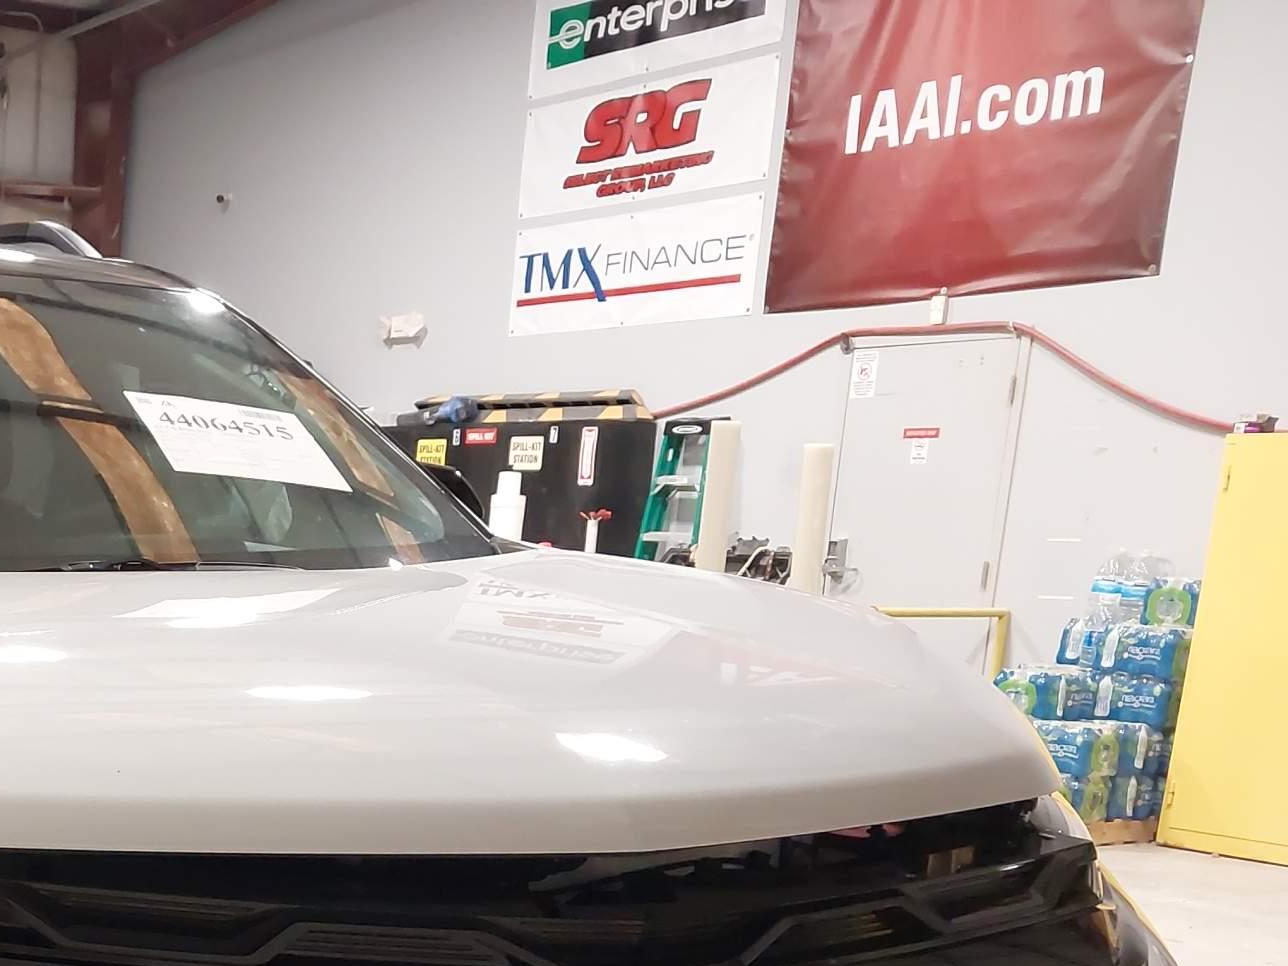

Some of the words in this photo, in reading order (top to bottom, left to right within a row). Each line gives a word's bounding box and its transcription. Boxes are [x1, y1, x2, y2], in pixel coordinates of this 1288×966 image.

[576, 78, 712, 164] SRG
[844, 66, 1104, 155] IAAI.com
[519, 243, 607, 302] TMX
[605, 234, 747, 276] FINANCE
[159, 411, 294, 441] 44064515
[512, 441, 542, 451] SPILL-KIT
[513, 454, 538, 464] STATION
